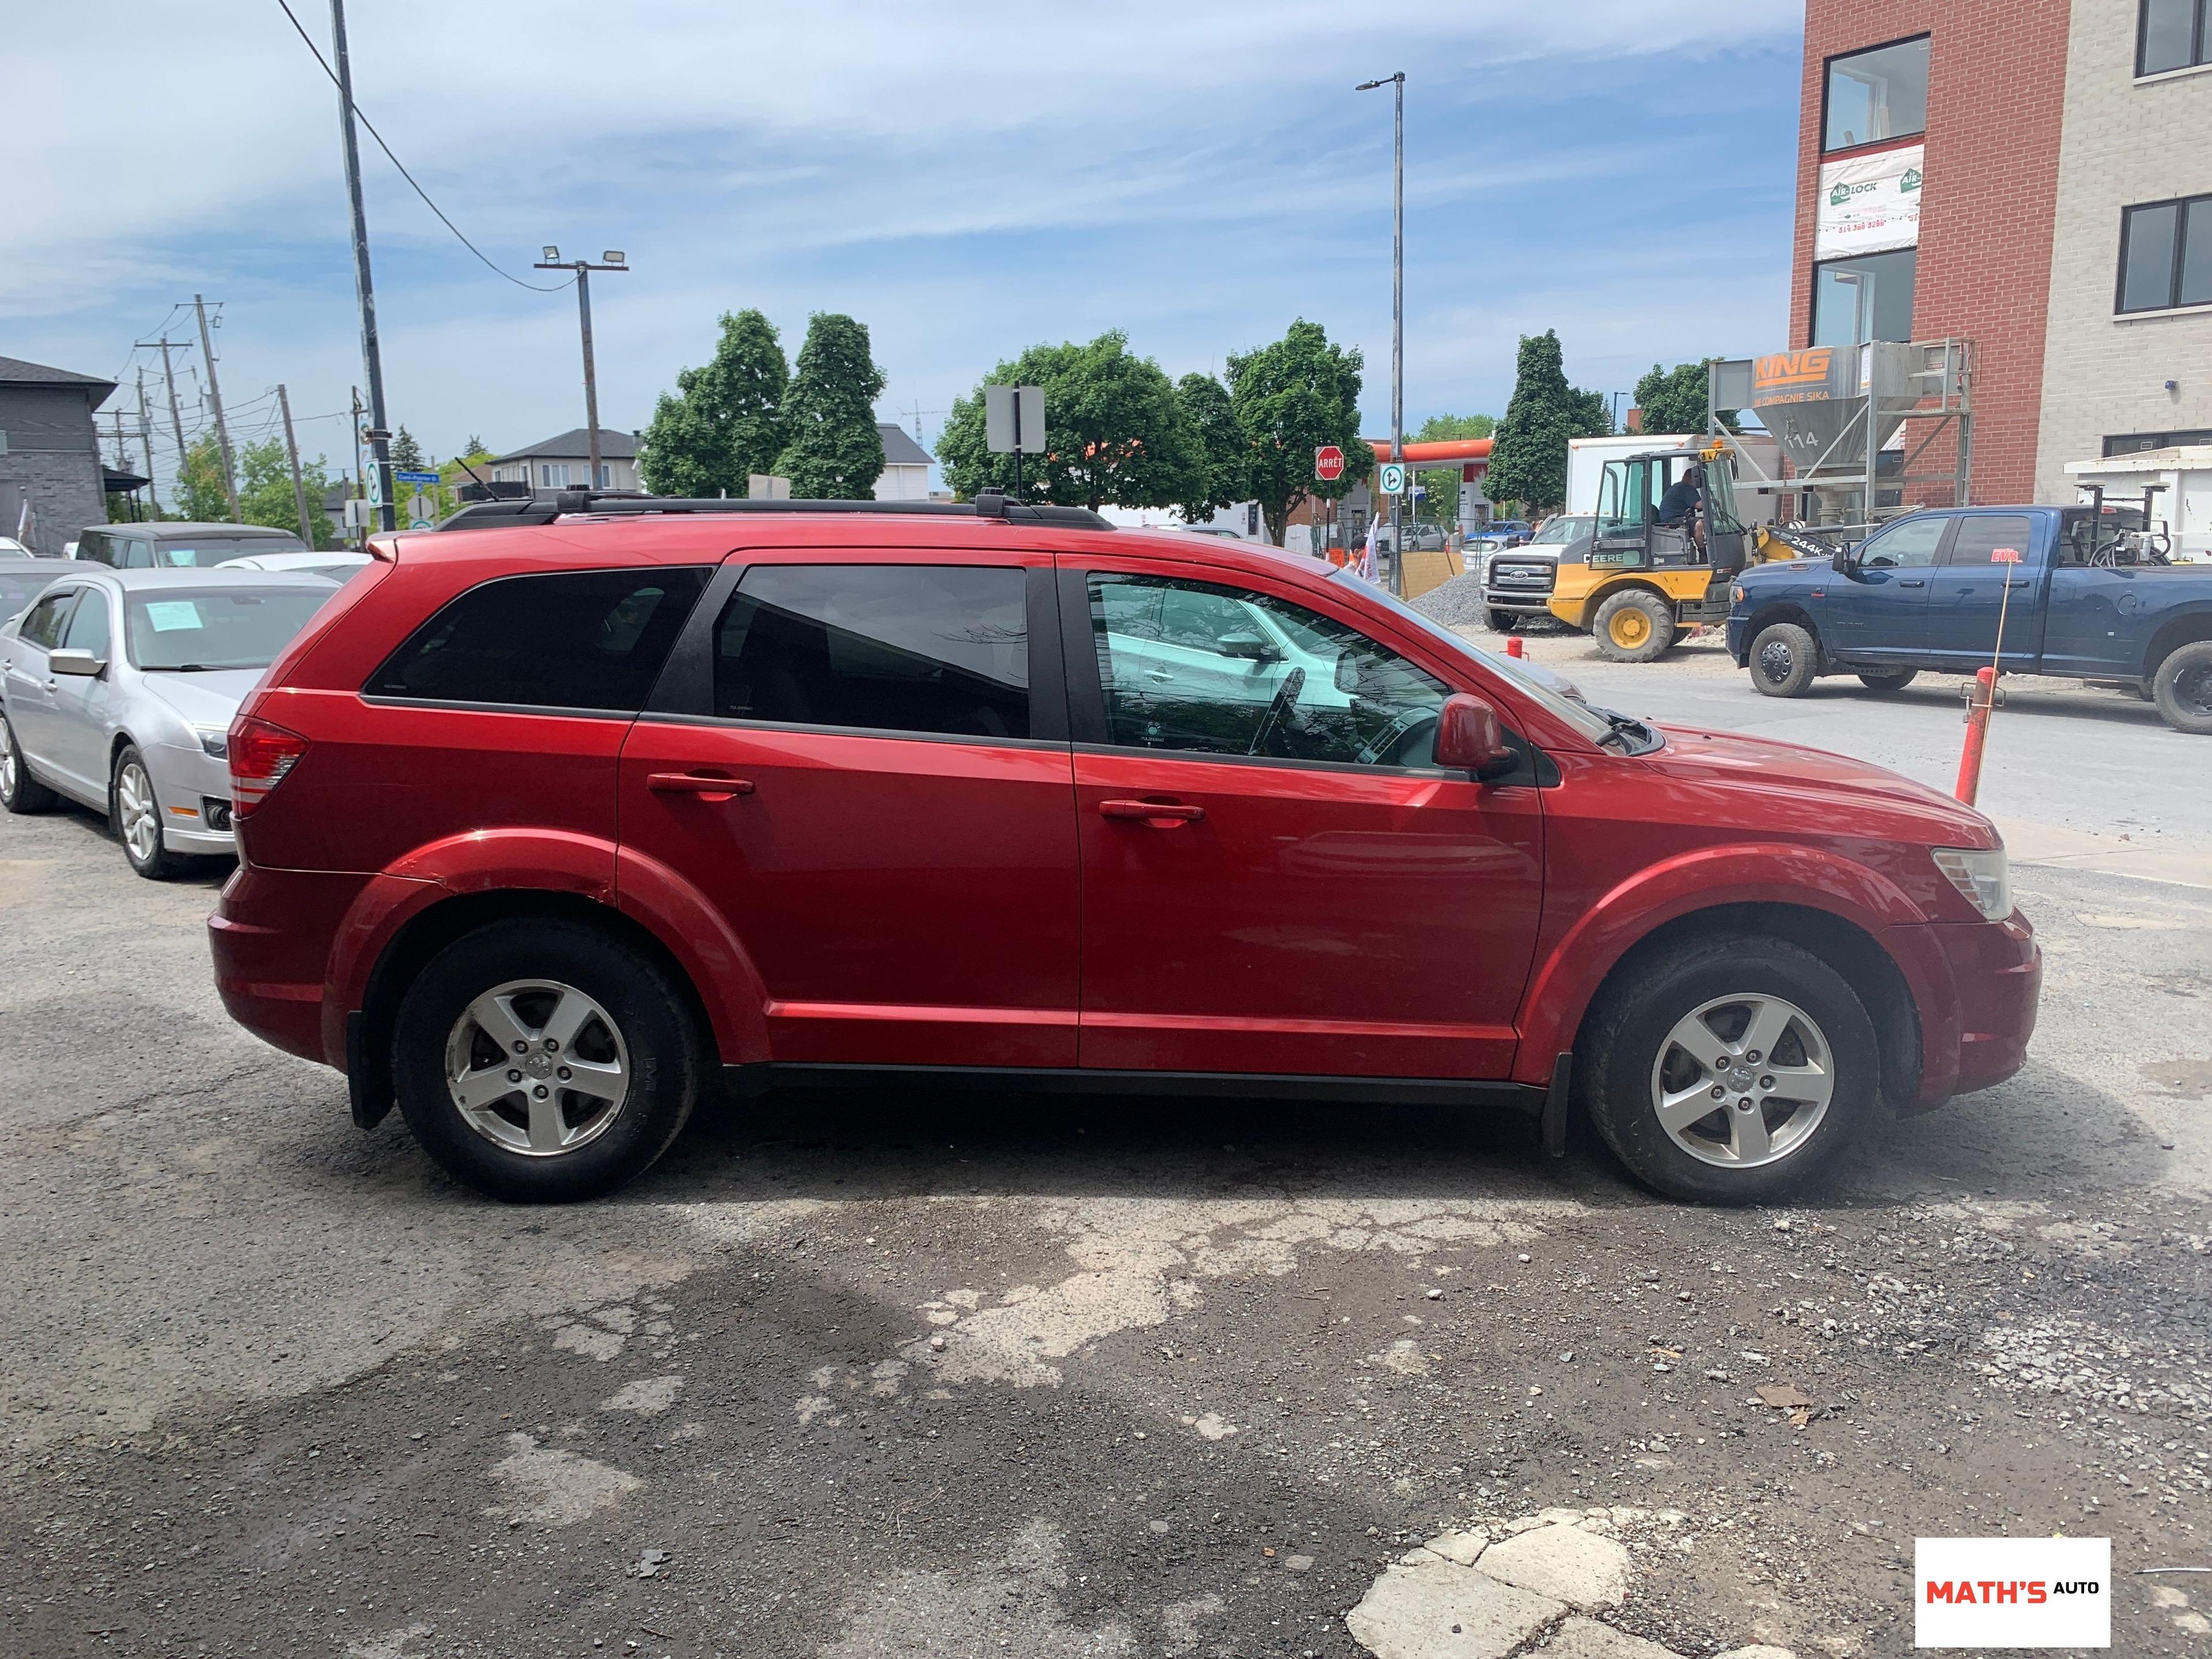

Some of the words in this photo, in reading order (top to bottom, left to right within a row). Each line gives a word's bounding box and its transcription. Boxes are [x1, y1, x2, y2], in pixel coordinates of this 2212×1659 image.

[1756, 350, 1832, 380] KING
[1762, 392, 1804, 406] COMPAGNIE
[1806, 391, 1830, 402] SIKA
[1319, 456, 1342, 468] ARRÊT
[1583, 553, 1623, 563] DEERE
